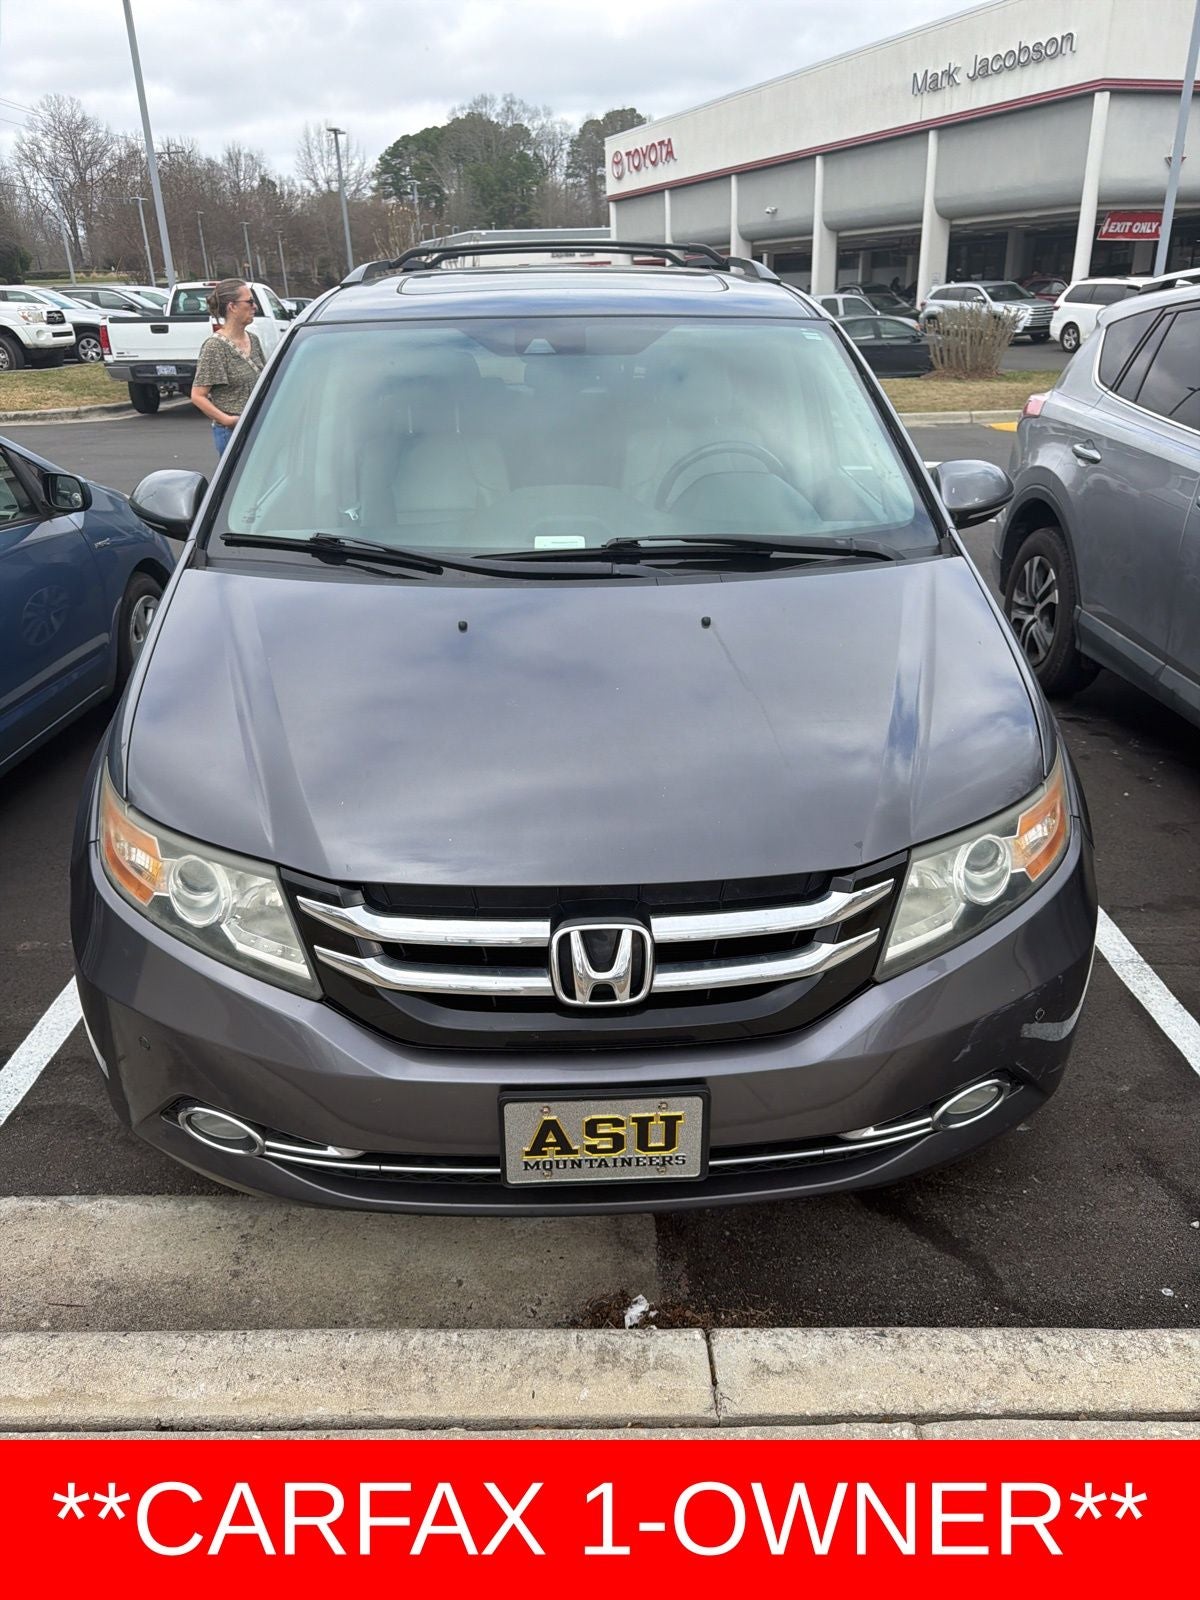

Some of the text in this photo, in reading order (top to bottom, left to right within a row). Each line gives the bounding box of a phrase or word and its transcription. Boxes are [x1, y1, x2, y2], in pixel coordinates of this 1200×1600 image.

[911, 31, 1076, 96] Mark Jacobson
[625, 138, 678, 173] TOYOTA
[1108, 222, 1159, 233] EXIT ONLY
[522, 1111, 686, 1160] ASU
[522, 1155, 687, 1172] MOUNTAINEERS
